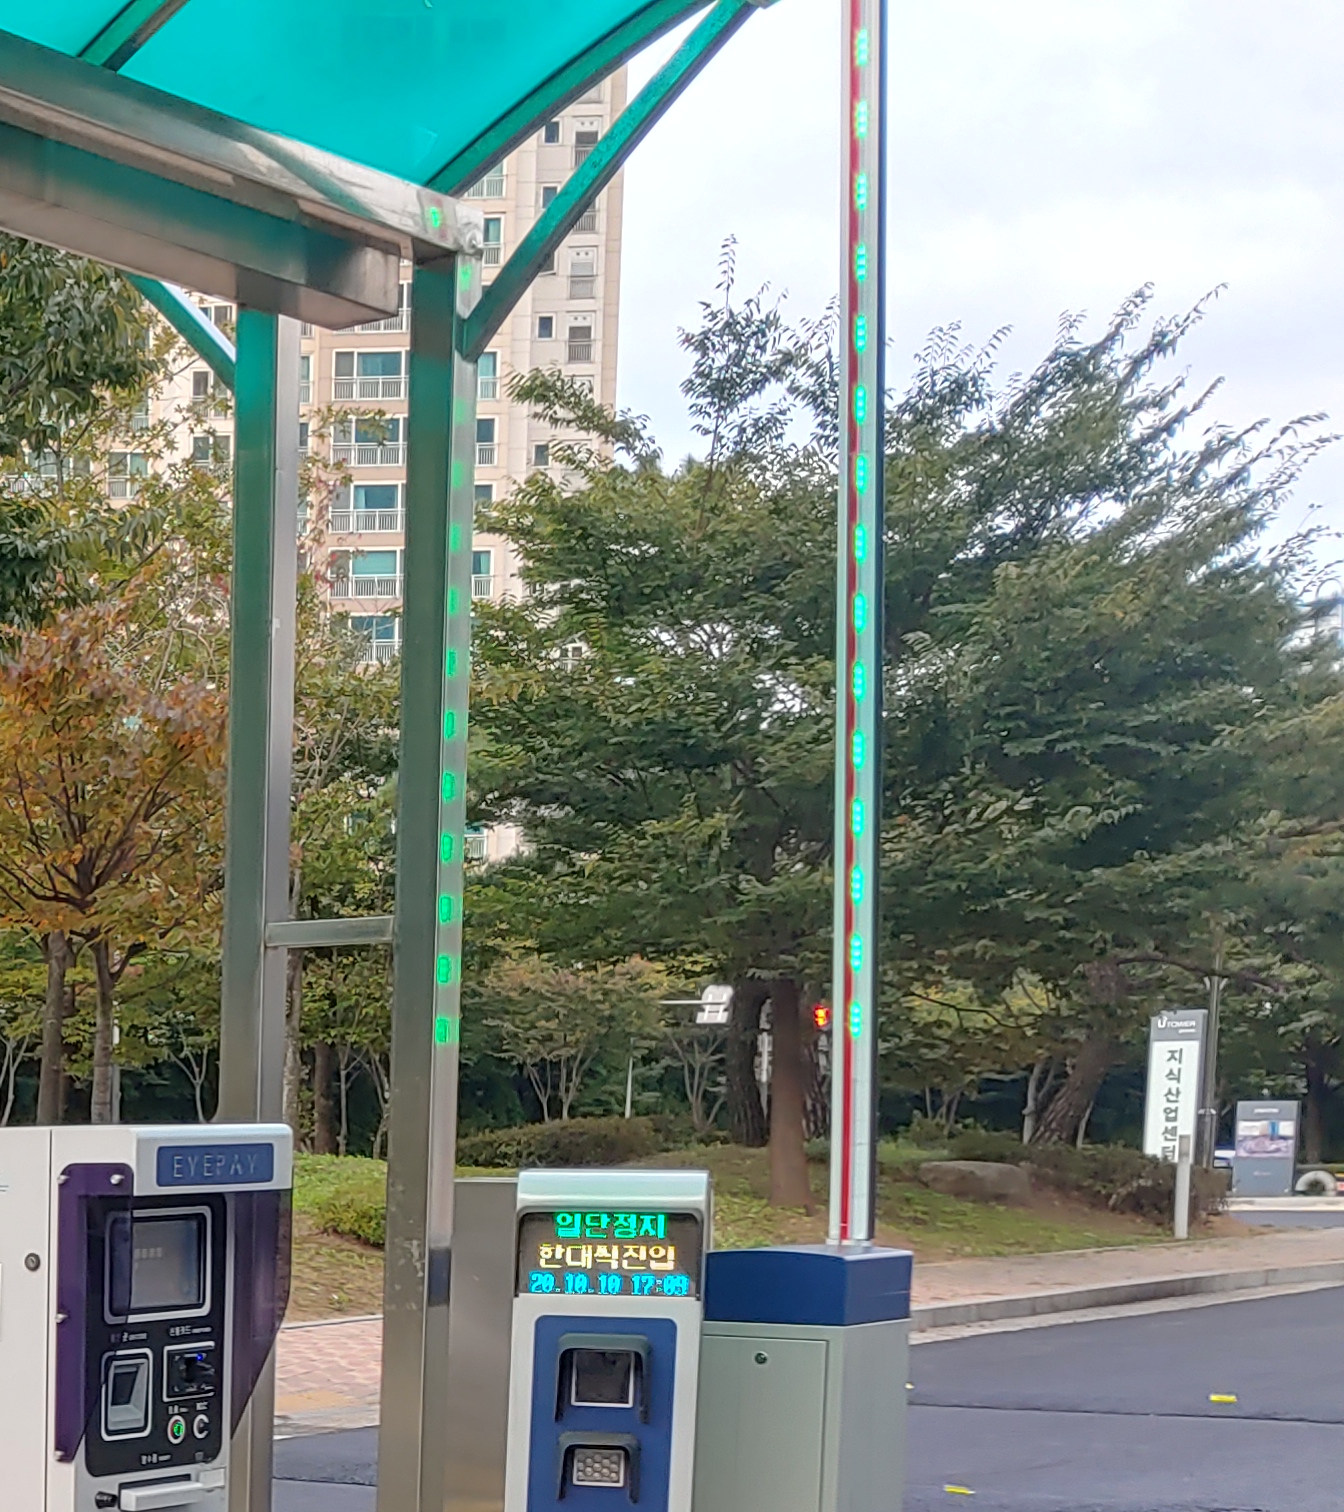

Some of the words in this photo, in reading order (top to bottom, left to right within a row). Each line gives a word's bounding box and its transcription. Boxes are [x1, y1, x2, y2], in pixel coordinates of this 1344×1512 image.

[1160, 1048, 1183, 1161] 지식산업센터
[173, 1153, 259, 1178] EYEPAY
[555, 1211, 667, 1239] 일단정지
[538, 1243, 676, 1270] 한대씩진입
